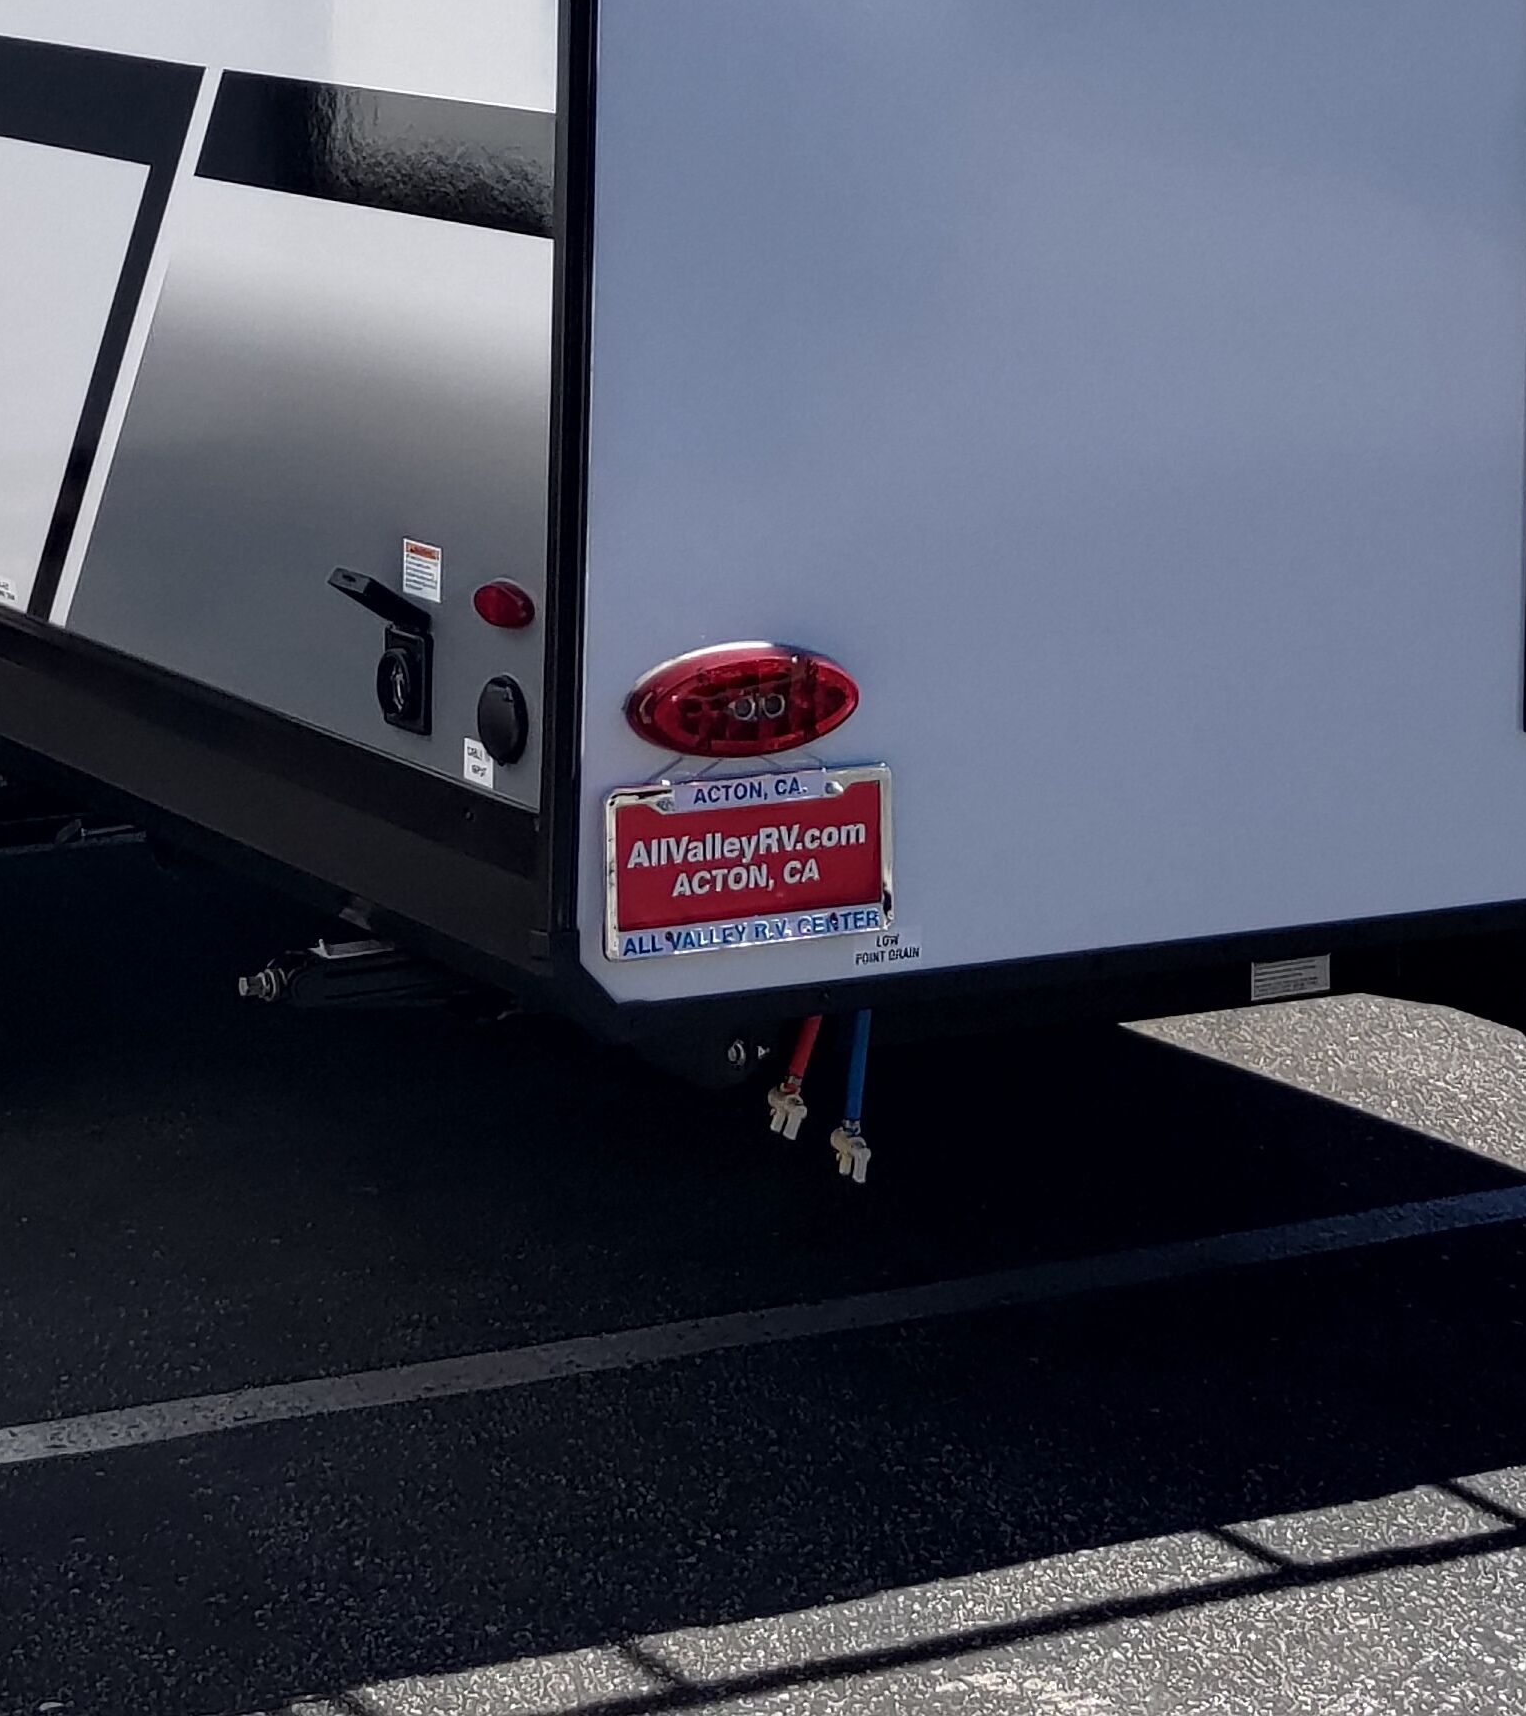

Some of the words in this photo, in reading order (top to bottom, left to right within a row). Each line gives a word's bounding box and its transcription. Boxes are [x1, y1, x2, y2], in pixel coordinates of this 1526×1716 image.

[692, 781, 768, 805] ACTON,
[627, 822, 867, 870] AllValleyRV.com
[671, 862, 775, 897] ACTON,
[782, 857, 821, 885] CA
[622, 934, 663, 957] ALL
[667, 922, 748, 953] VALLEY
[797, 907, 881, 936] CENTER
